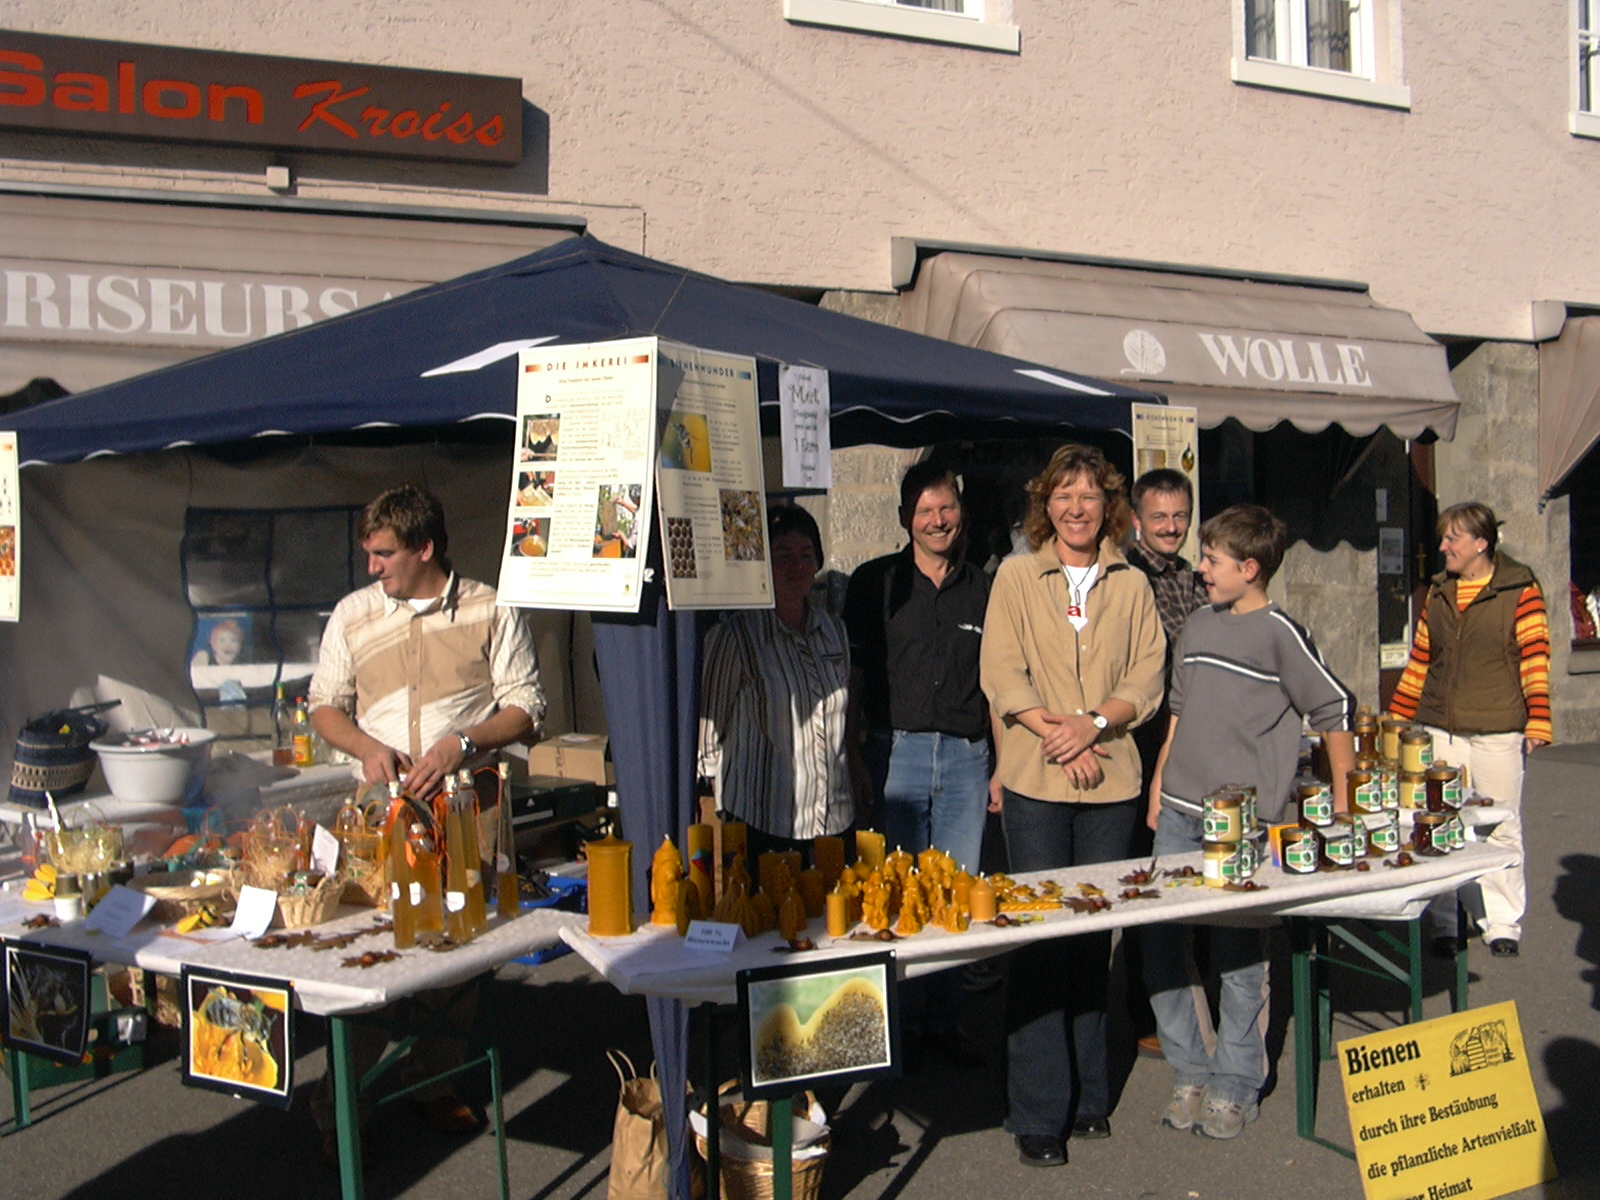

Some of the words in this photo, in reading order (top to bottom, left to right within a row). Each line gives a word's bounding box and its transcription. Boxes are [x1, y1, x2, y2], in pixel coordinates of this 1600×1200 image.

[0, 50, 263, 124] Salon
[293, 80, 505, 146] Kroiss
[547, 361, 567, 371] DIE
[576, 356, 627, 369] IMKEREI
[1198, 333, 1372, 388] WOLLE
[1345, 1039, 1421, 1076] Bienen
[1352, 1079, 1406, 1104] erhalten
[1359, 1118, 1398, 1142] durch
[1400, 1113, 1427, 1131] ihre
[1429, 1093, 1499, 1123] Bestäubung
[1367, 1160, 1387, 1180] die
[1390, 1142, 1458, 1177] pflanzliche
[1461, 1119, 1537, 1154] Artenvielfalt
[1427, 1177, 1473, 1200] Heimat
